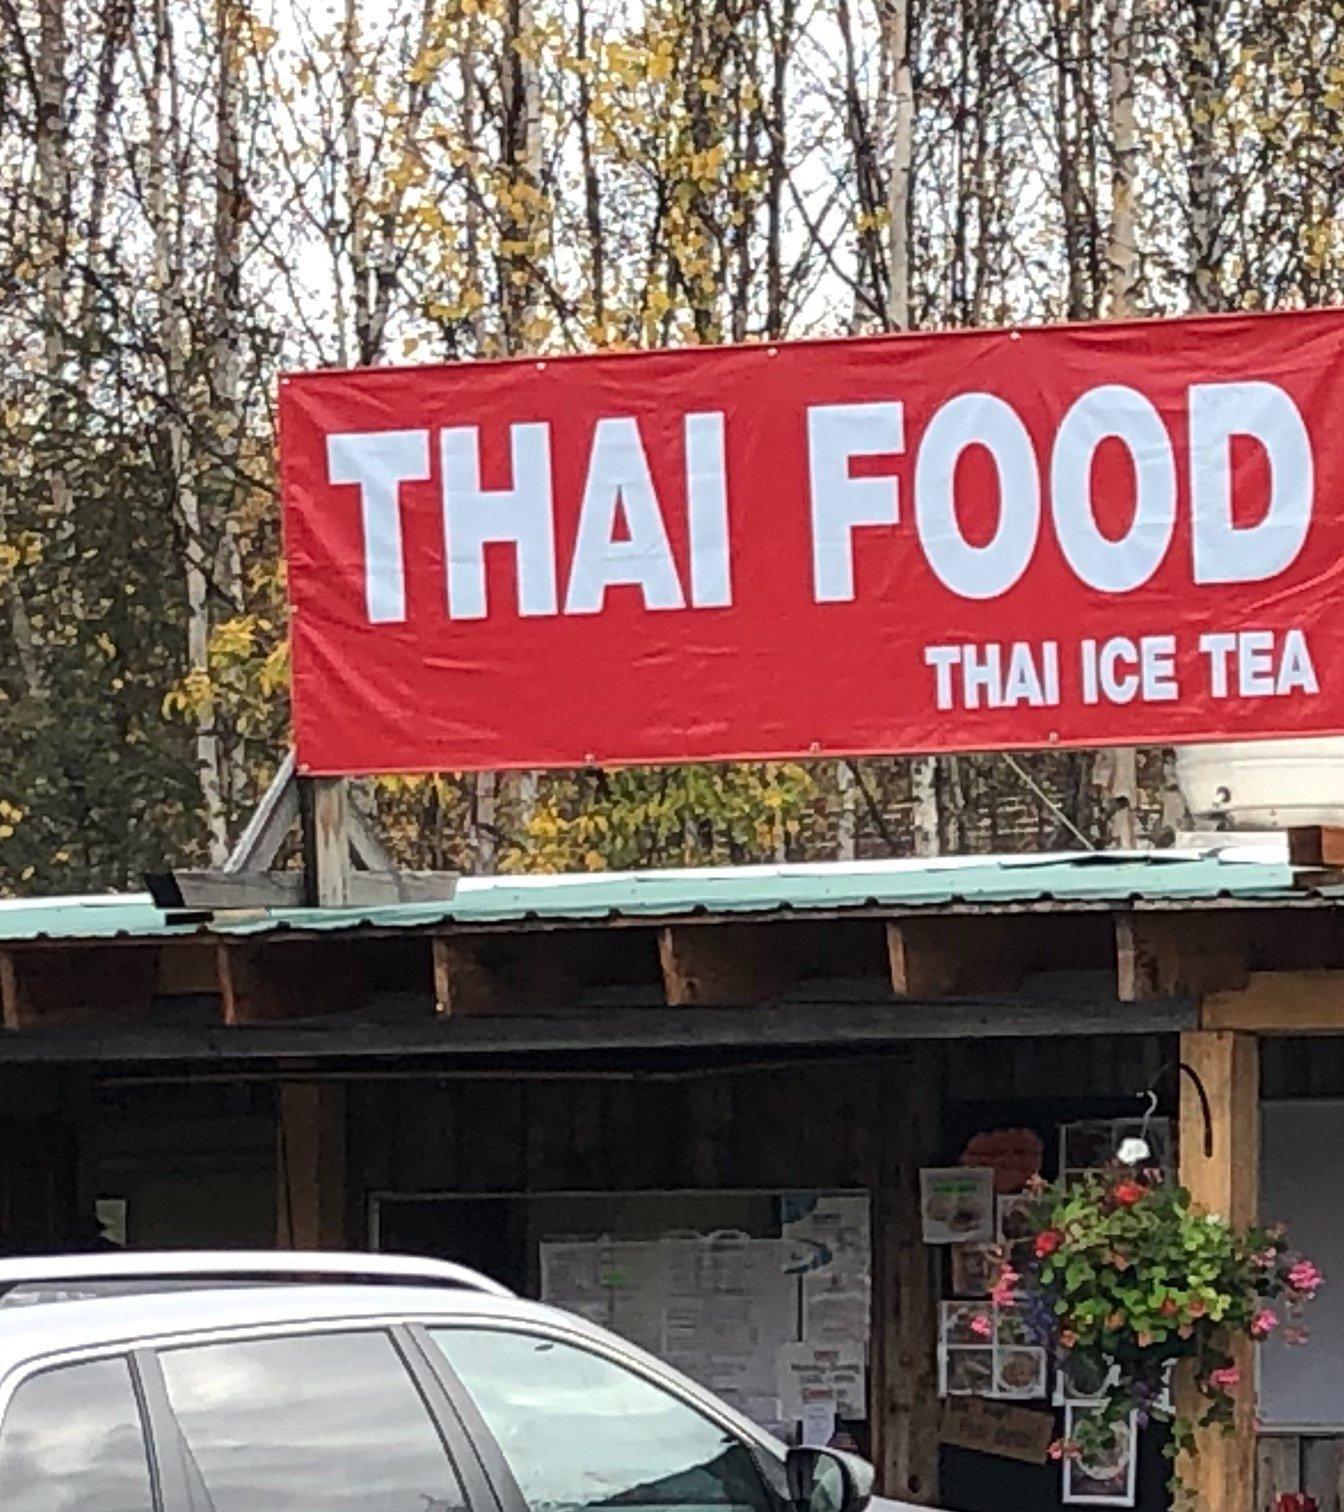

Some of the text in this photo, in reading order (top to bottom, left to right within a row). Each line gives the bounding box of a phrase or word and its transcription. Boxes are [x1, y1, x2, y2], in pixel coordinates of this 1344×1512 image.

[325, 379, 1317, 627] THAI FOOD
[922, 627, 1321, 713] THAI ICE TEA
